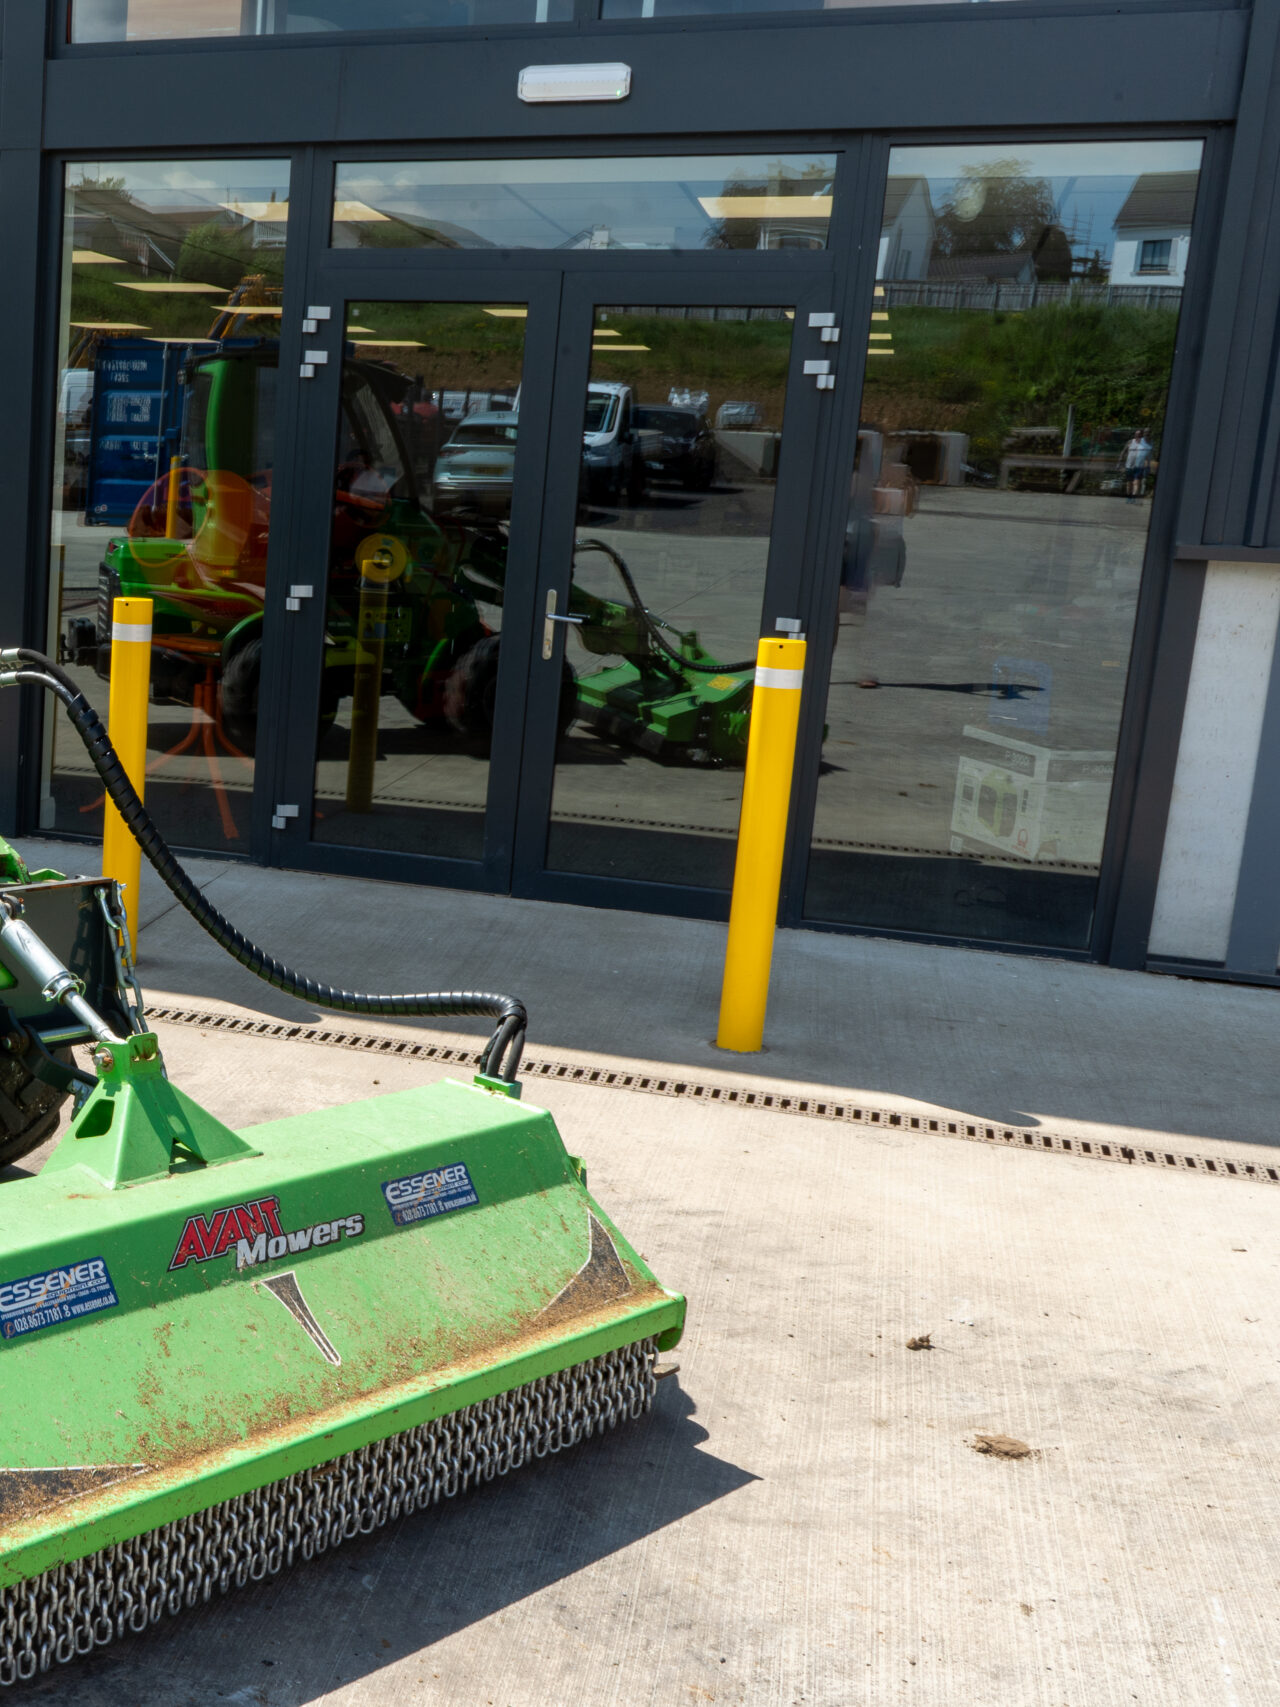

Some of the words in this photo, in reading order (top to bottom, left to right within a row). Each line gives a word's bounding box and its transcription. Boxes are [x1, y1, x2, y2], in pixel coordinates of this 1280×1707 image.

[386, 1165, 467, 1204] ESSENER
[167, 1195, 283, 1272] AVANT
[236, 1214, 365, 1269] Mowers
